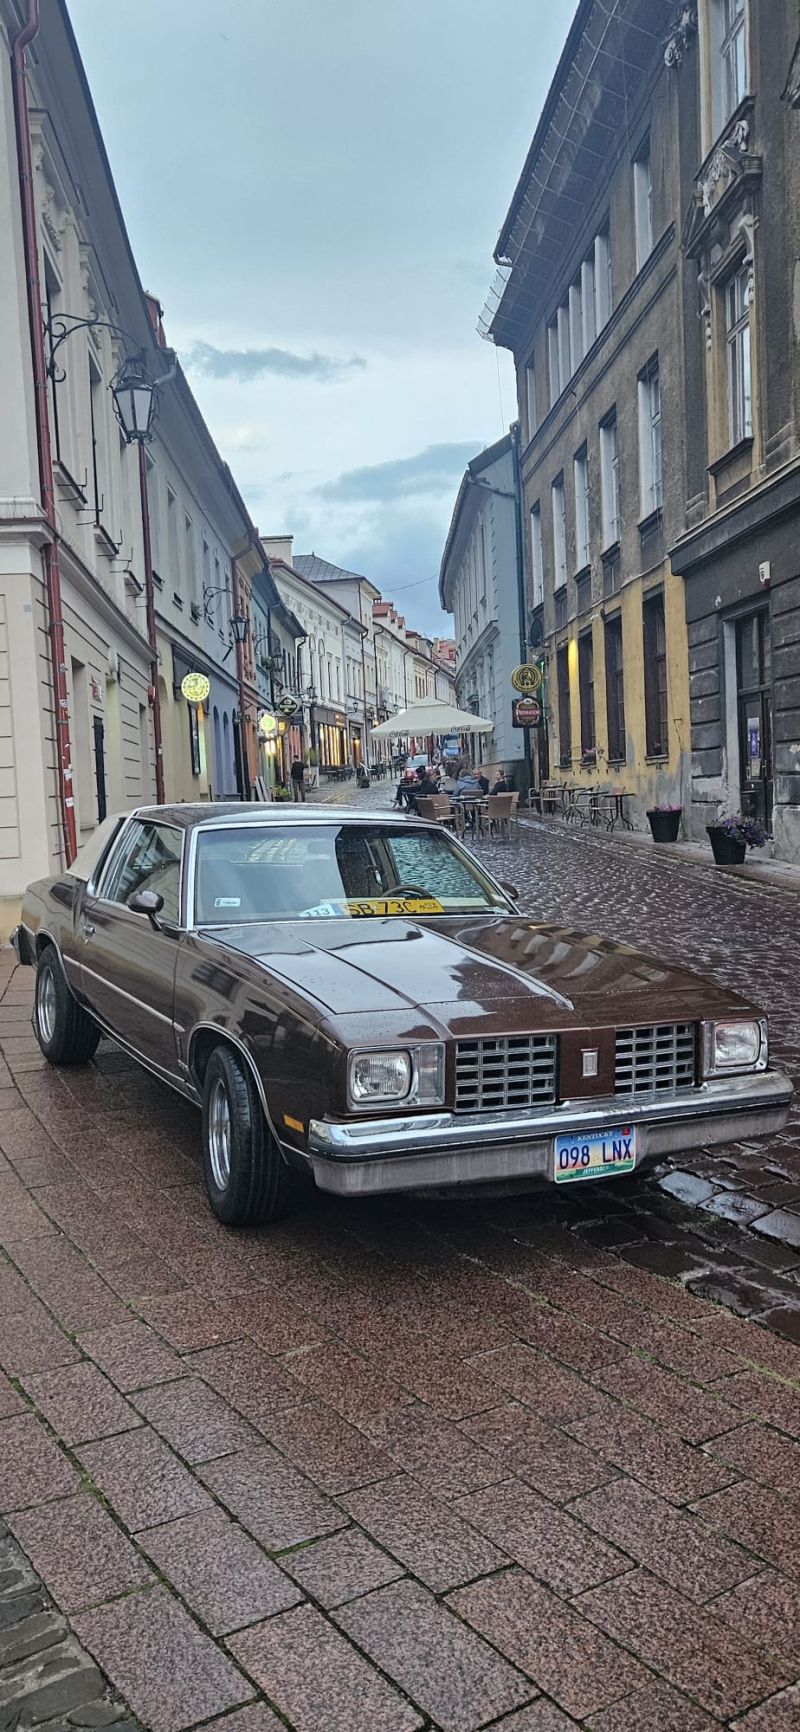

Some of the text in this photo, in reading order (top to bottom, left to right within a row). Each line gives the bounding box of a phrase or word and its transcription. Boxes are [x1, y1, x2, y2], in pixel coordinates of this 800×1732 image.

[577, 1131, 613, 1141] KENTUCKY
[560, 1138, 632, 1169] 098 LNX
